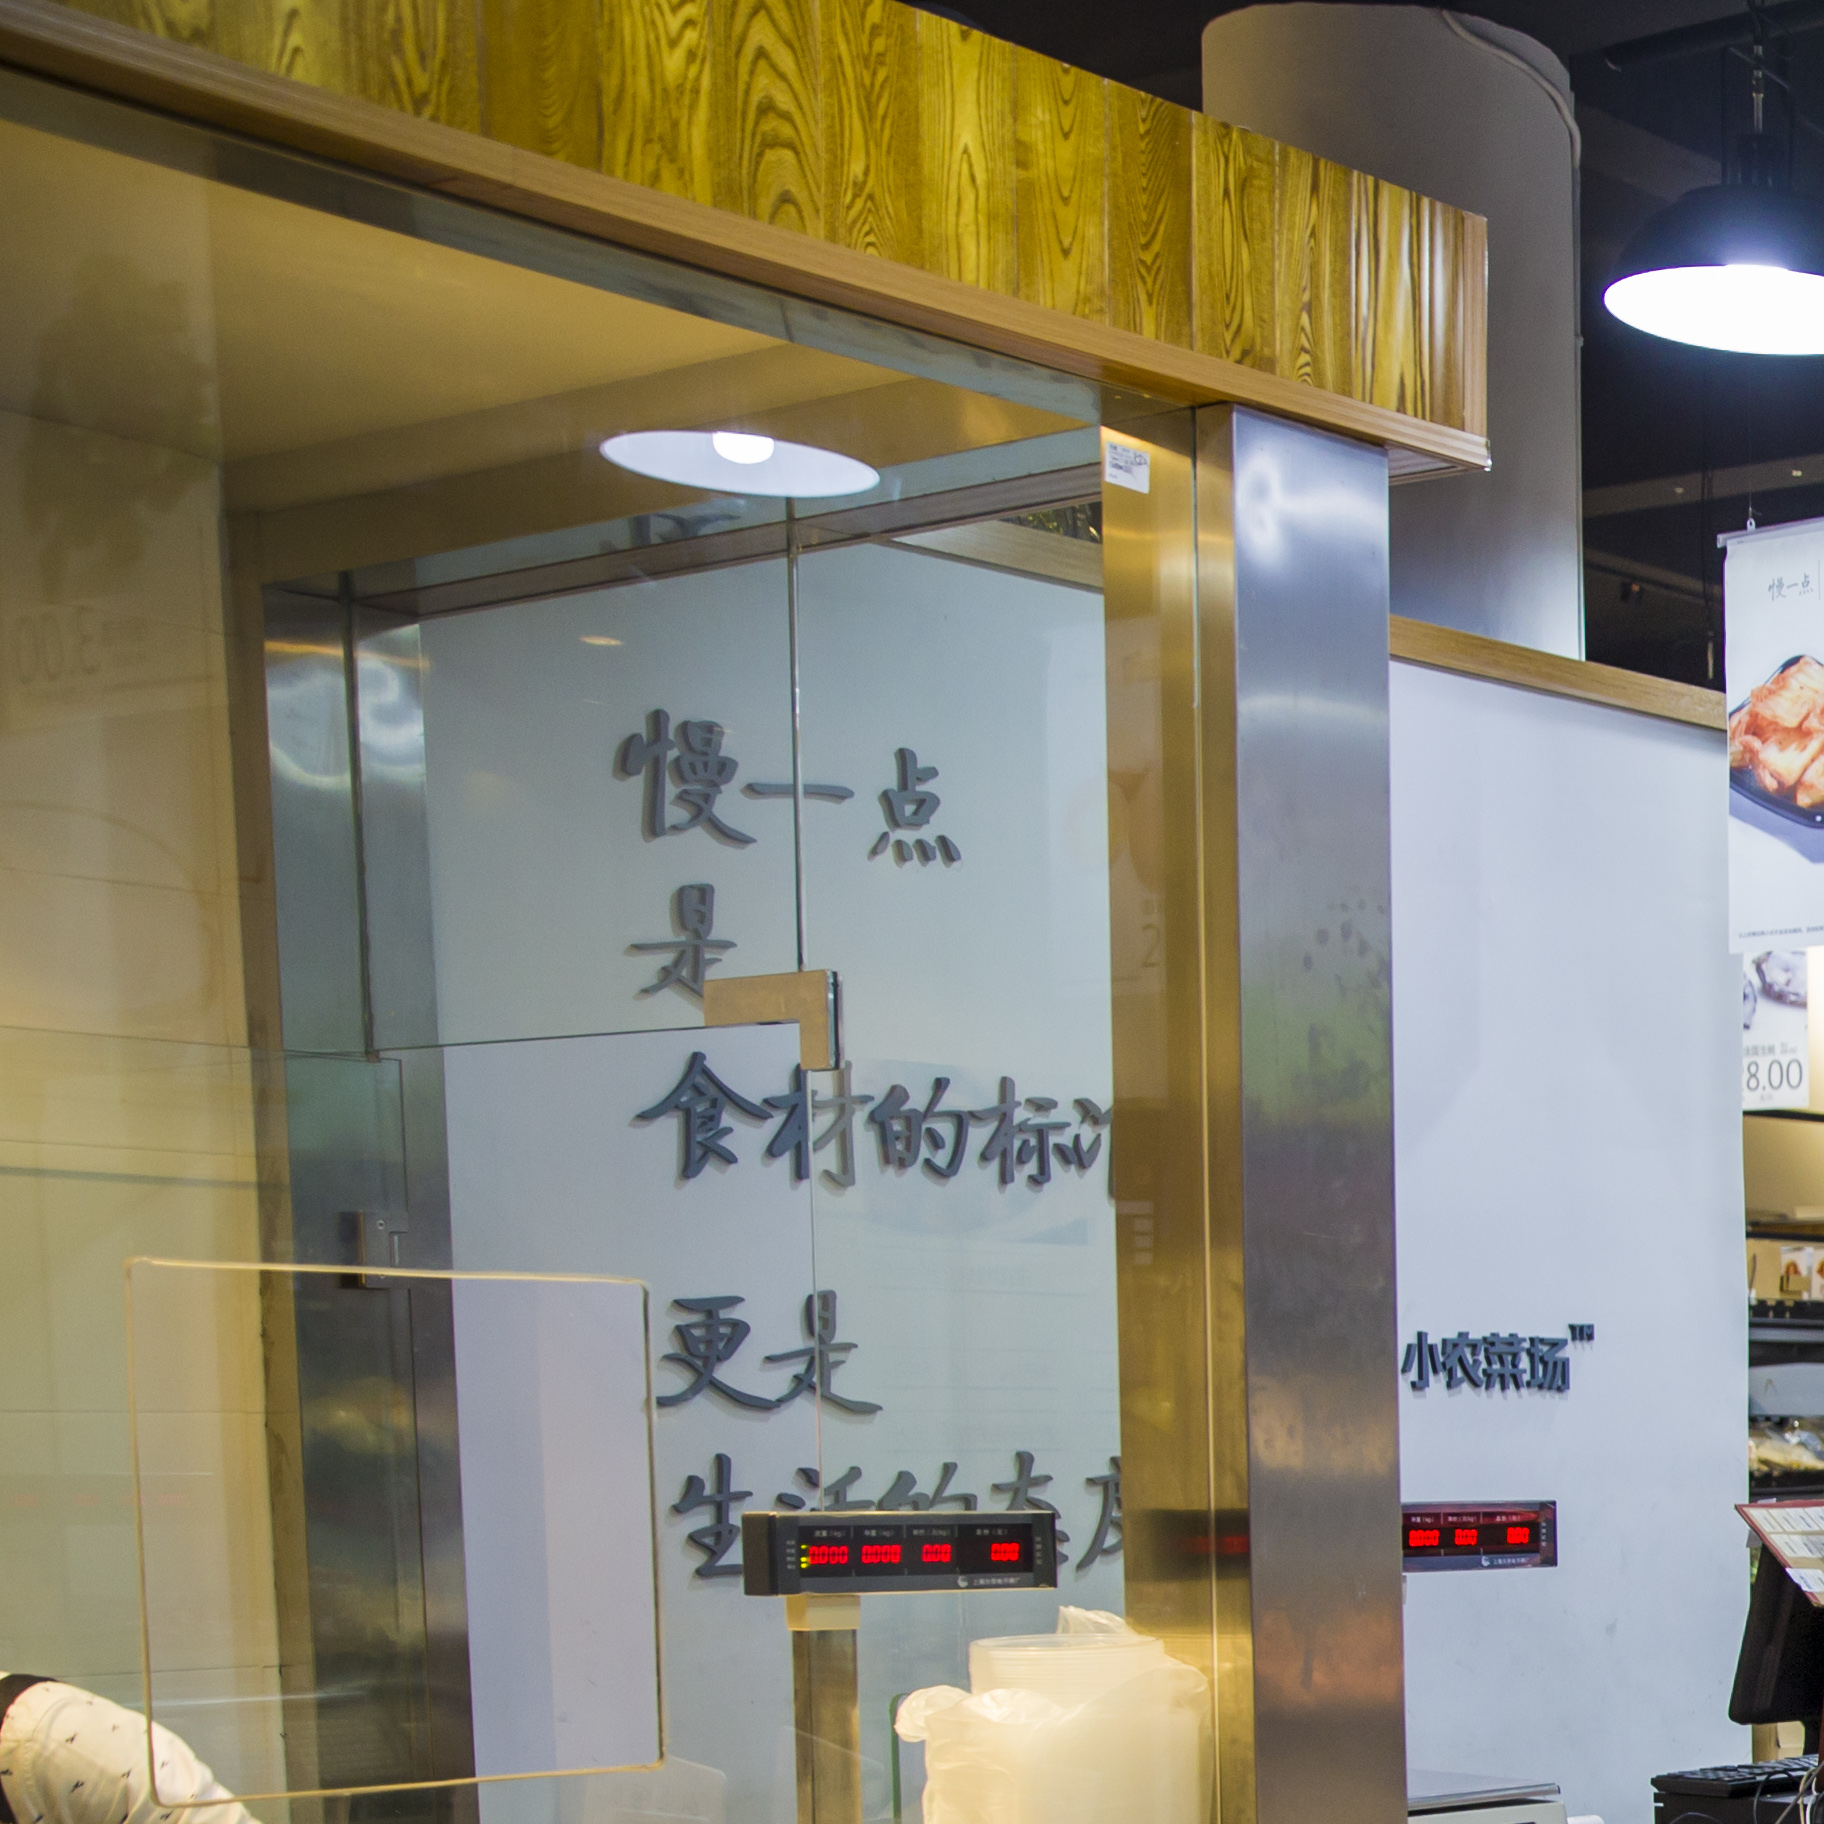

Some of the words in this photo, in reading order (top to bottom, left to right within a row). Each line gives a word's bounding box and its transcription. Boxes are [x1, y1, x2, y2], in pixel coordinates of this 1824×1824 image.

[1768, 573, 1814, 601] 慢一点
[614, 709, 962, 864] 慢一点
[628, 884, 738, 999] 是
[655, 1289, 883, 1413] 更是
[1401, 1331, 1571, 1393] 小农菜场
